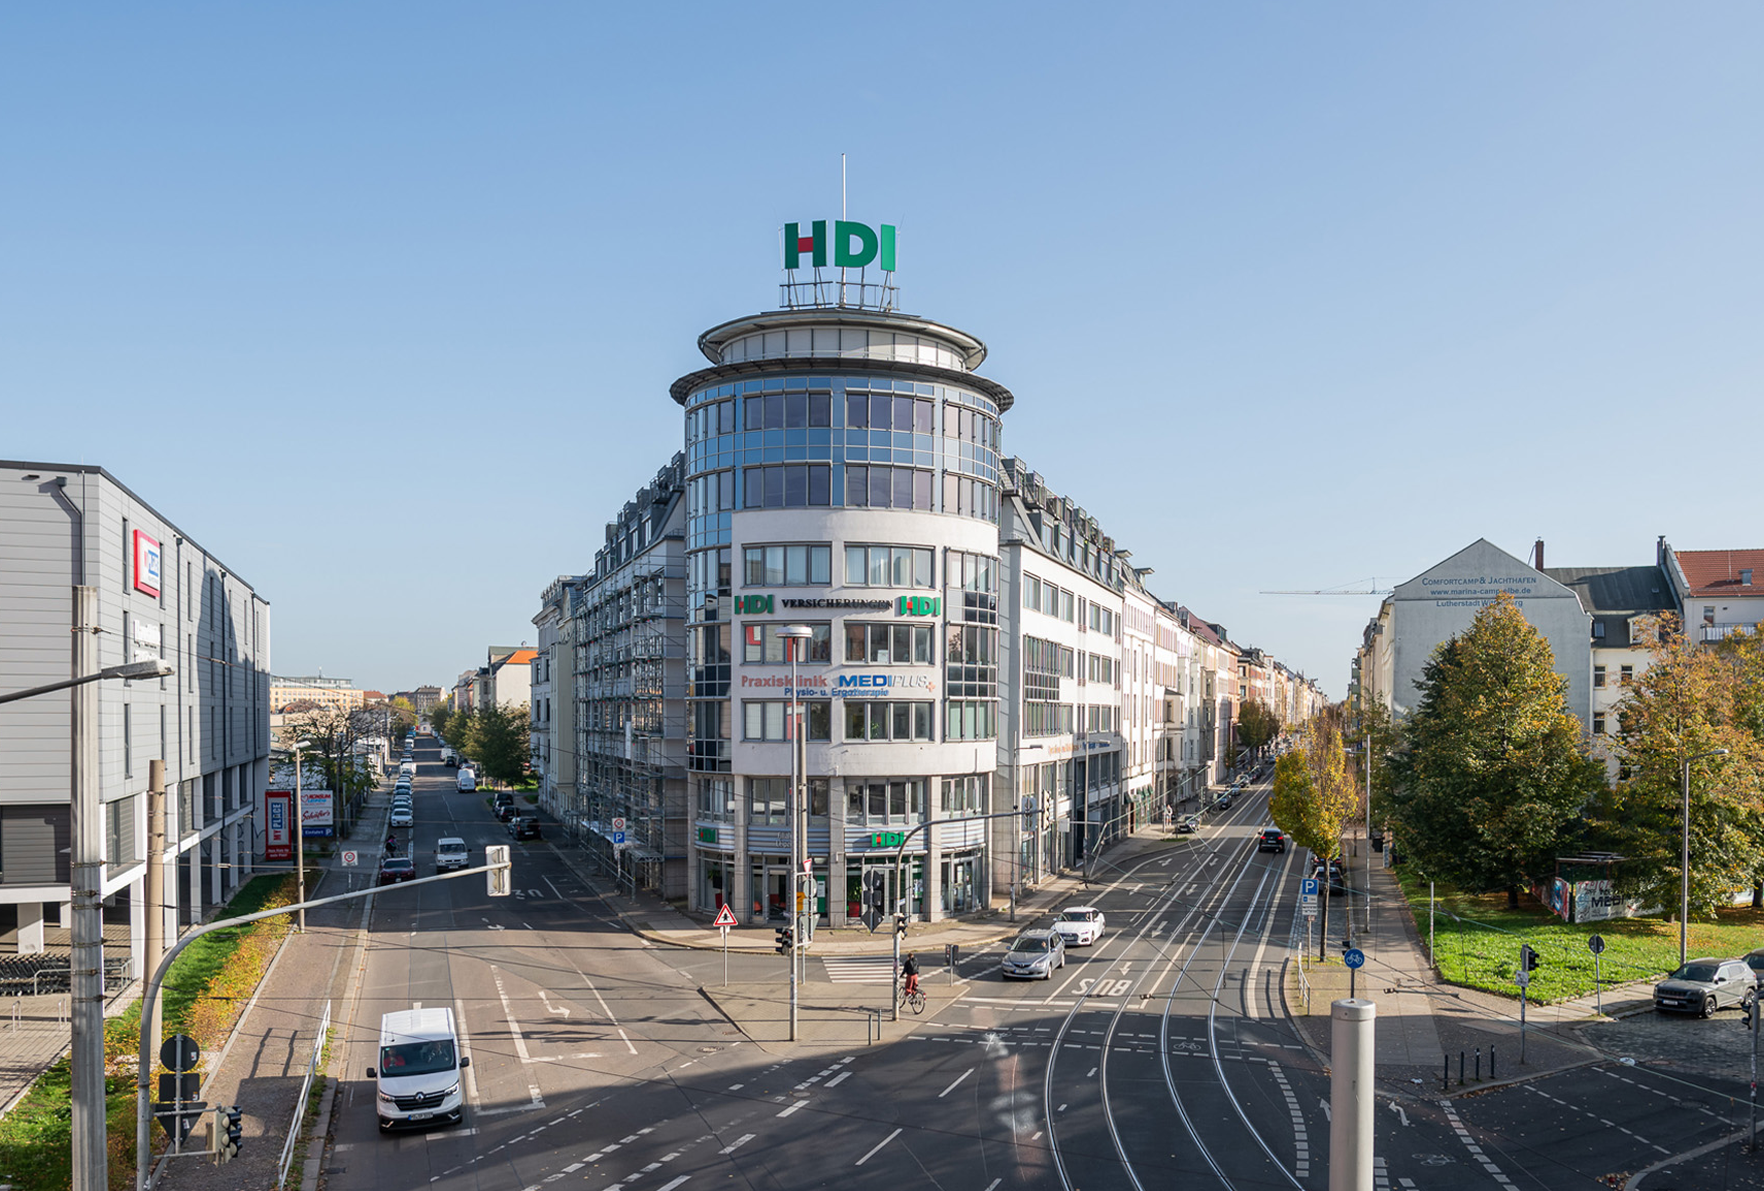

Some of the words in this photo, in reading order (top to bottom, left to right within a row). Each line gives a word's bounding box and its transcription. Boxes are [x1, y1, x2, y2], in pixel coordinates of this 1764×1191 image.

[784, 219, 896, 272] HDI
[734, 594, 774, 615] HDI
[781, 598, 893, 609] VERSICHERUNGEN
[900, 595, 941, 616] HDI
[831, 688, 889, 697] Ergotherapie
[872, 832, 904, 847] HDI
[1305, 880, 1315, 893] P
[1071, 978, 1133, 996] BUS
